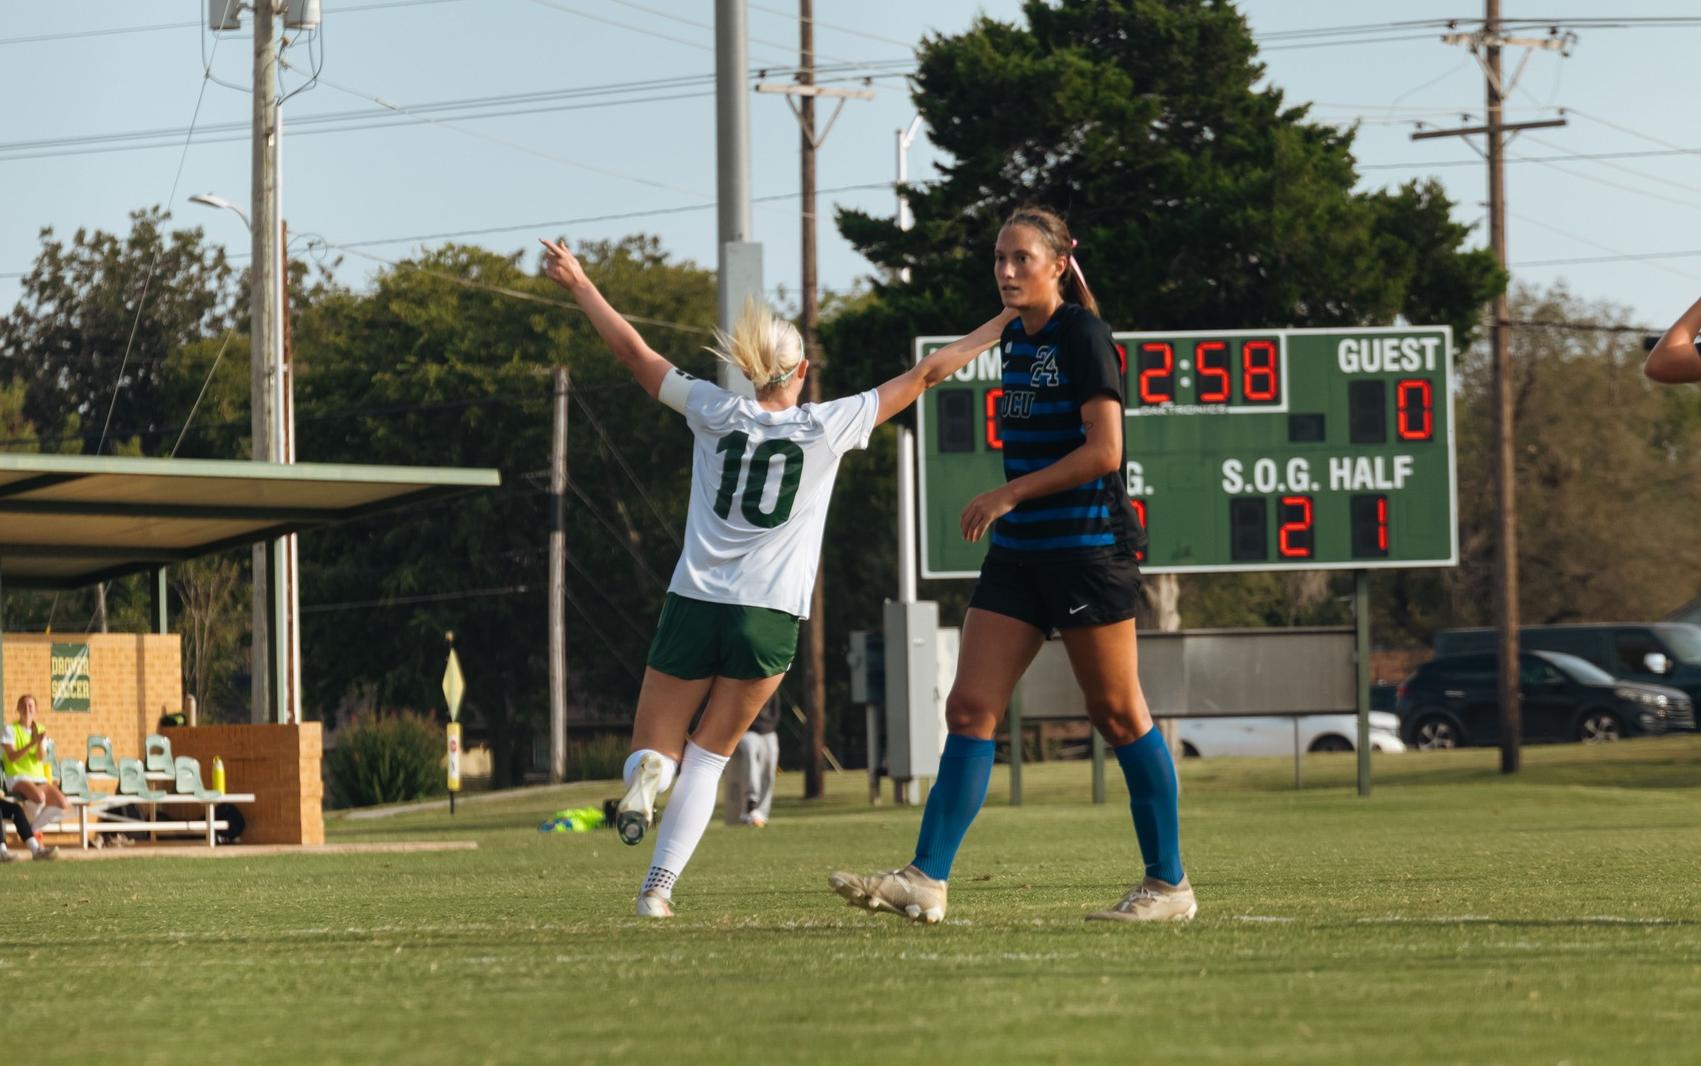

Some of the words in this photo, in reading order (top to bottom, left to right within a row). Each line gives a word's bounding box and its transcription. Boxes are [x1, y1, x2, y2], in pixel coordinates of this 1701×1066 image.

[1030, 345, 1059, 387] 24
[1338, 337, 1441, 374] GUEST
[1397, 379, 1433, 440] 0
[713, 430, 804, 529] 10
[1222, 457, 1320, 494] S.O.G.
[1329, 455, 1414, 491] HALF
[1279, 496, 1313, 557] 2
[1377, 498, 1388, 550] 1
